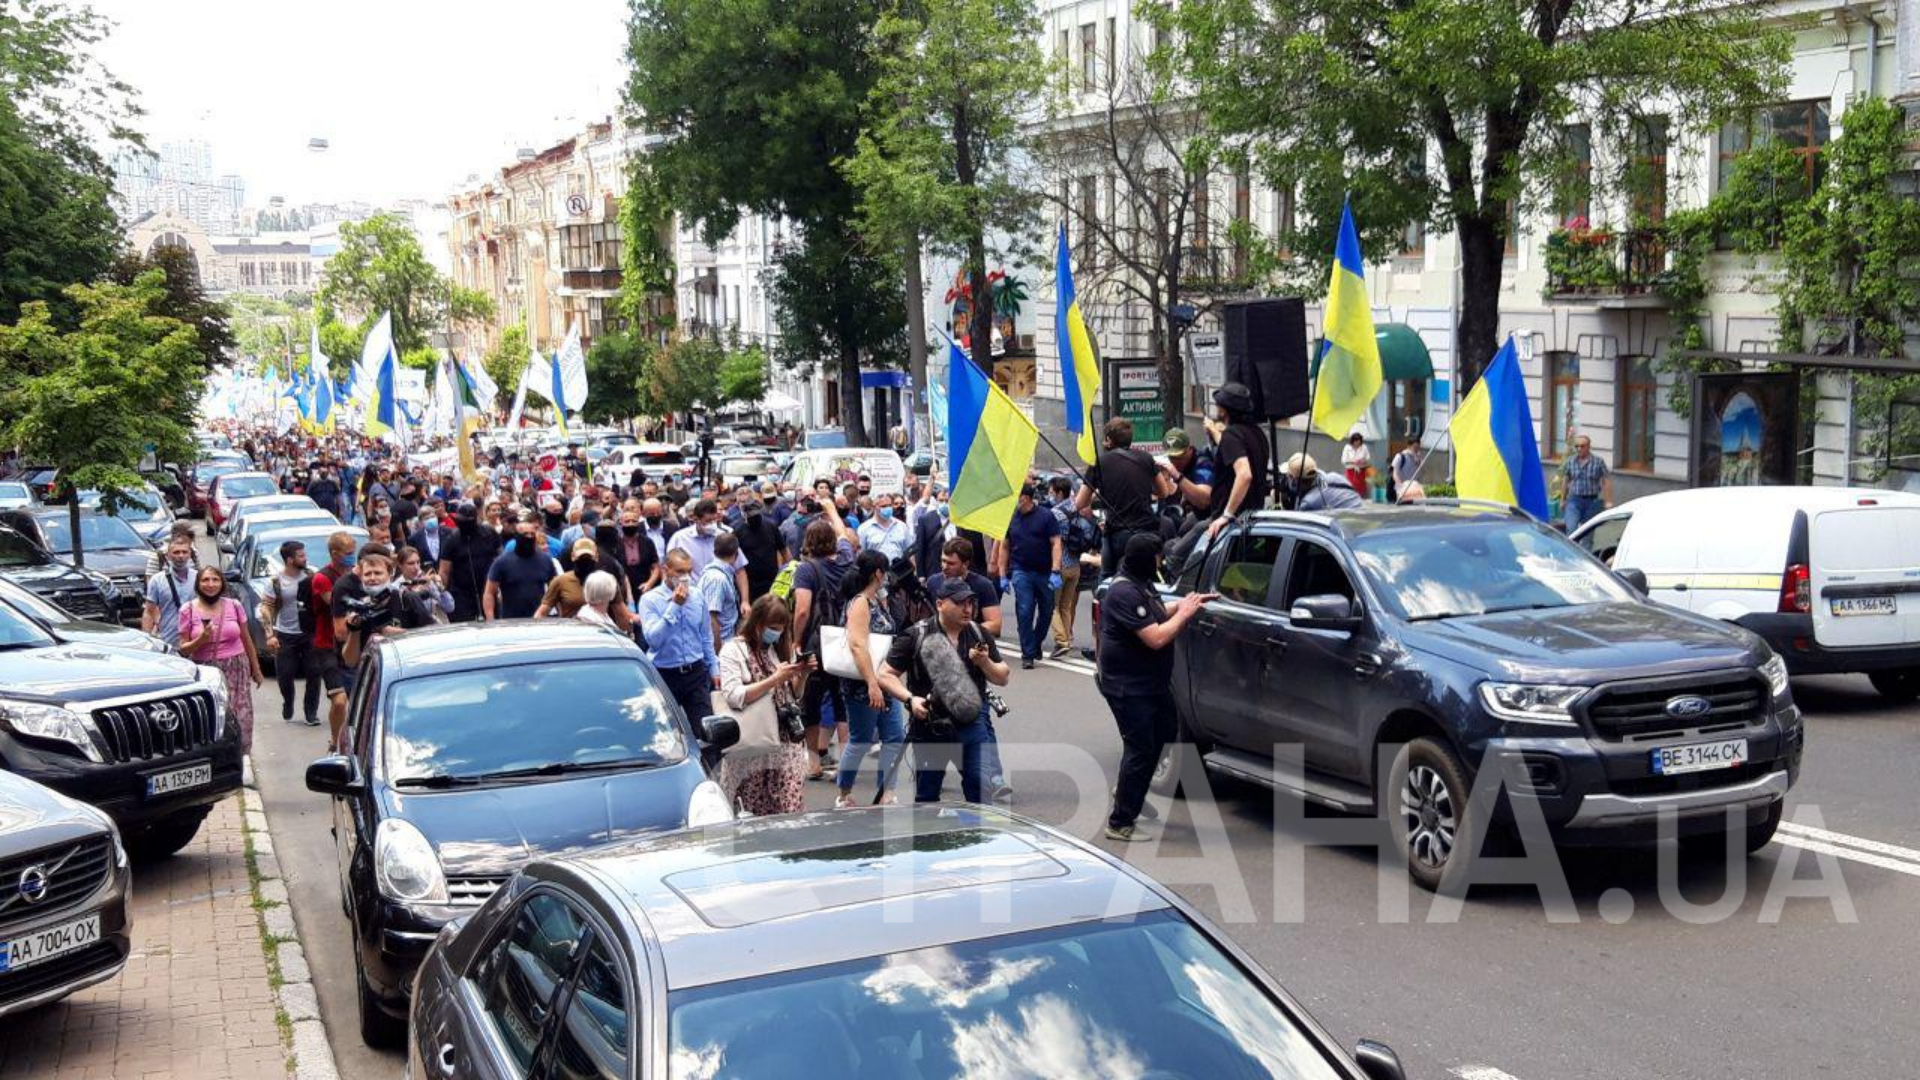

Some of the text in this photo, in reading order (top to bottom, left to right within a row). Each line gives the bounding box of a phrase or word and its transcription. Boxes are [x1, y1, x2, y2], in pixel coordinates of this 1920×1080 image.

[1840, 601, 1854, 611] AA
[1880, 598, 1894, 609] MA
[1662, 743, 1742, 767] BE 3144 CK
[154, 767, 209, 792] AA 1329 PM
[10, 919, 96, 963] AA 7004 OX
